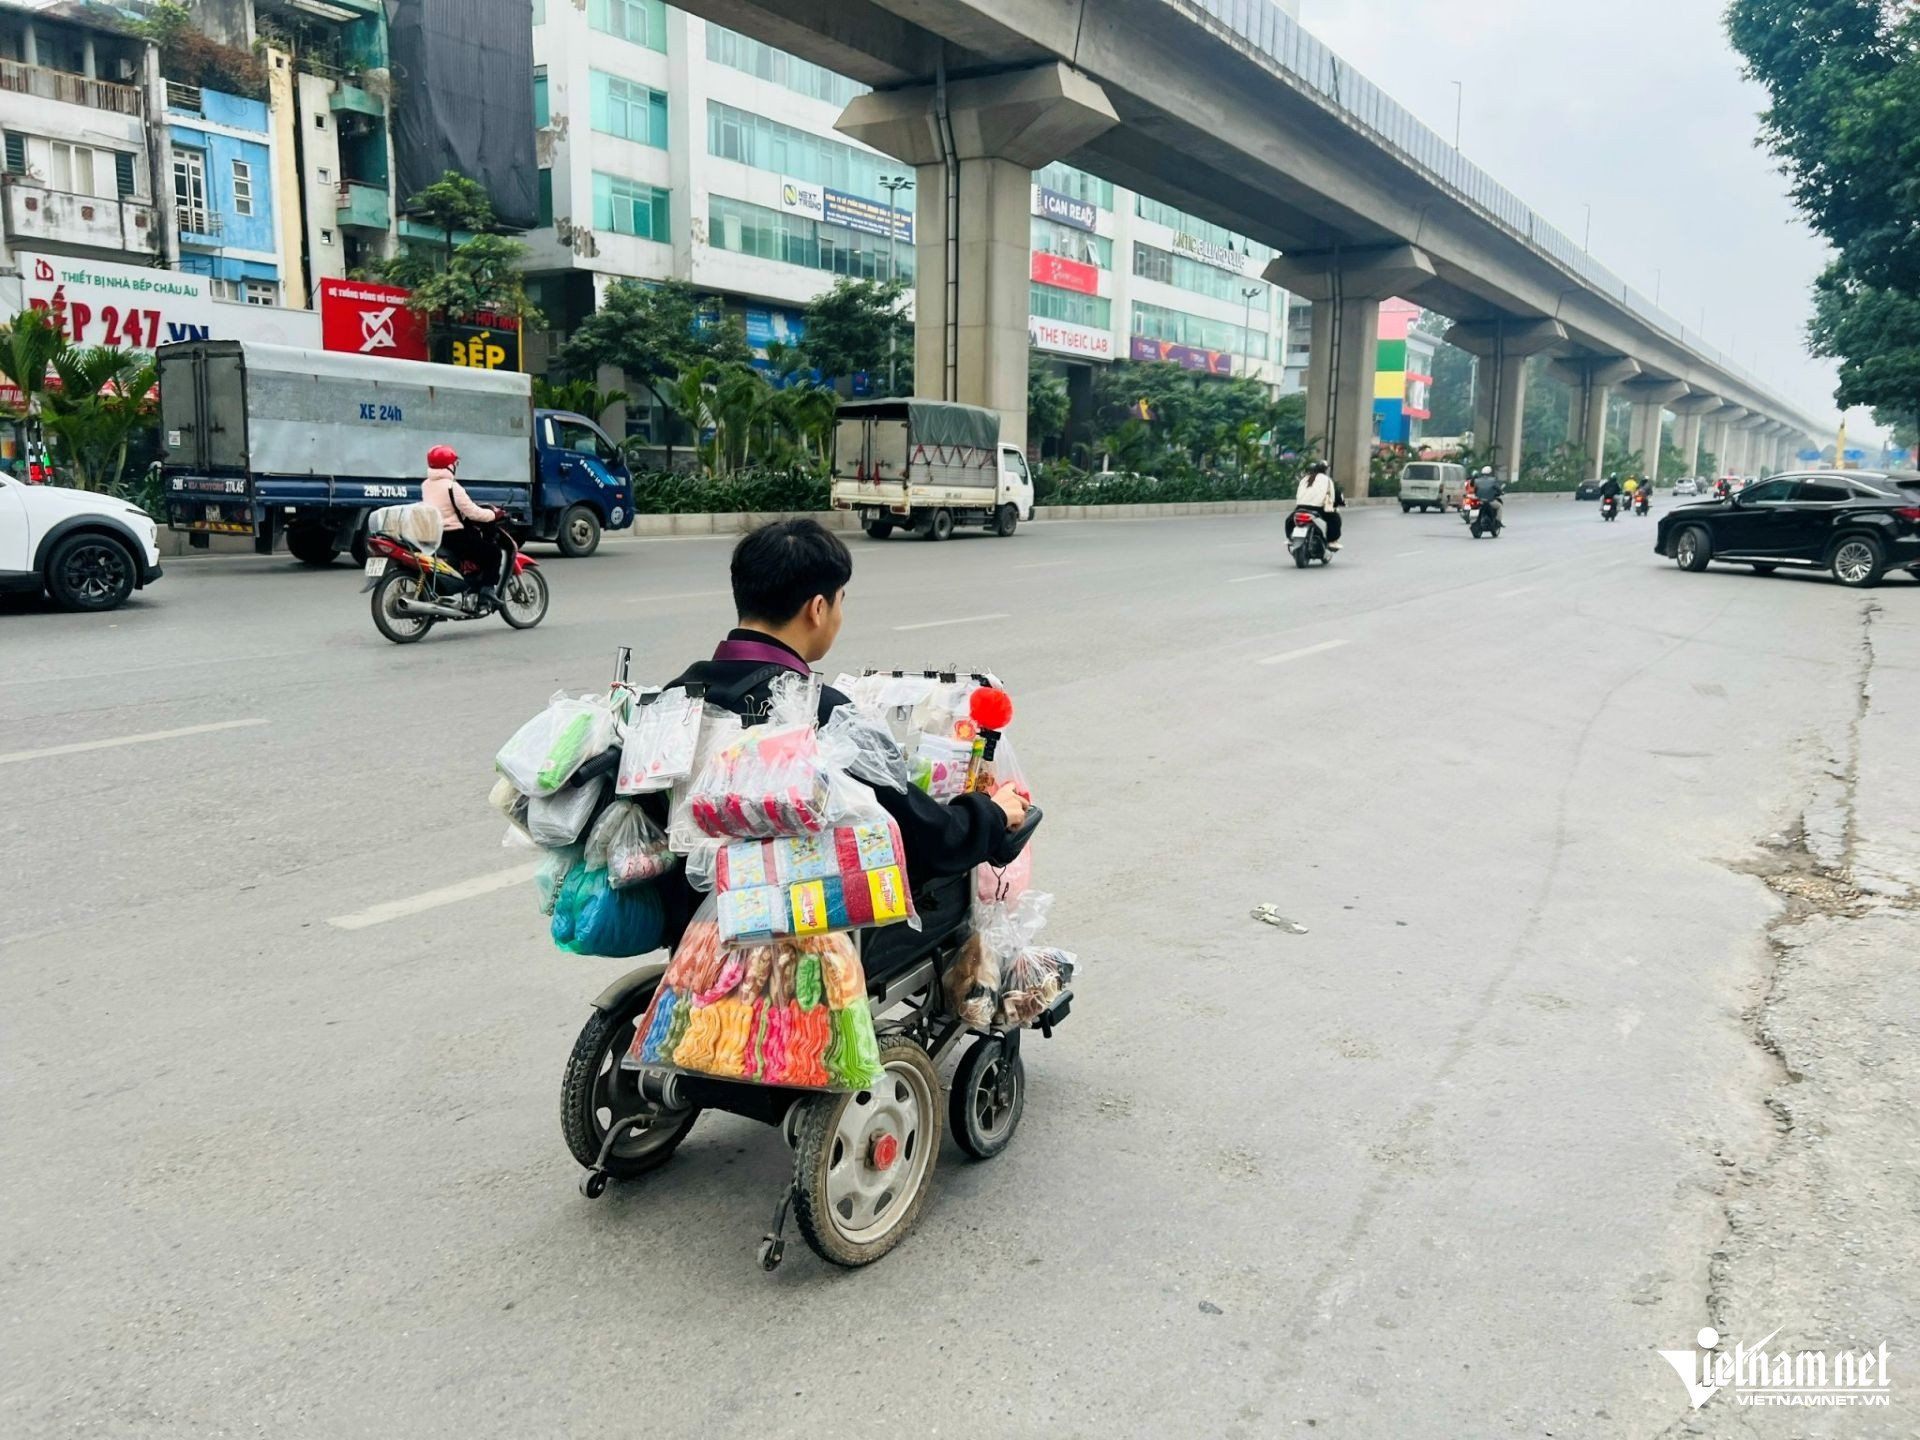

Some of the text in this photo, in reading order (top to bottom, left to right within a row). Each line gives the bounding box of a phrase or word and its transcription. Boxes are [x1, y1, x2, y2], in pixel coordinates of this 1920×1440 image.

[798, 190, 817, 201] NEXT
[798, 199, 822, 212] TREND
[1044, 195, 1092, 226] I CAN READ
[61, 270, 199, 298] THIẾT BỊ NHÀ BẾP CHÂU ÂU
[453, 331, 506, 369] BẾP
[1039, 326, 1058, 344] THE
[1061, 330, 1088, 350] TOEIC
[1090, 336, 1108, 353] LAB
[360, 403, 402, 422] XE 24h
[199, 482, 225, 492] MOTORS
